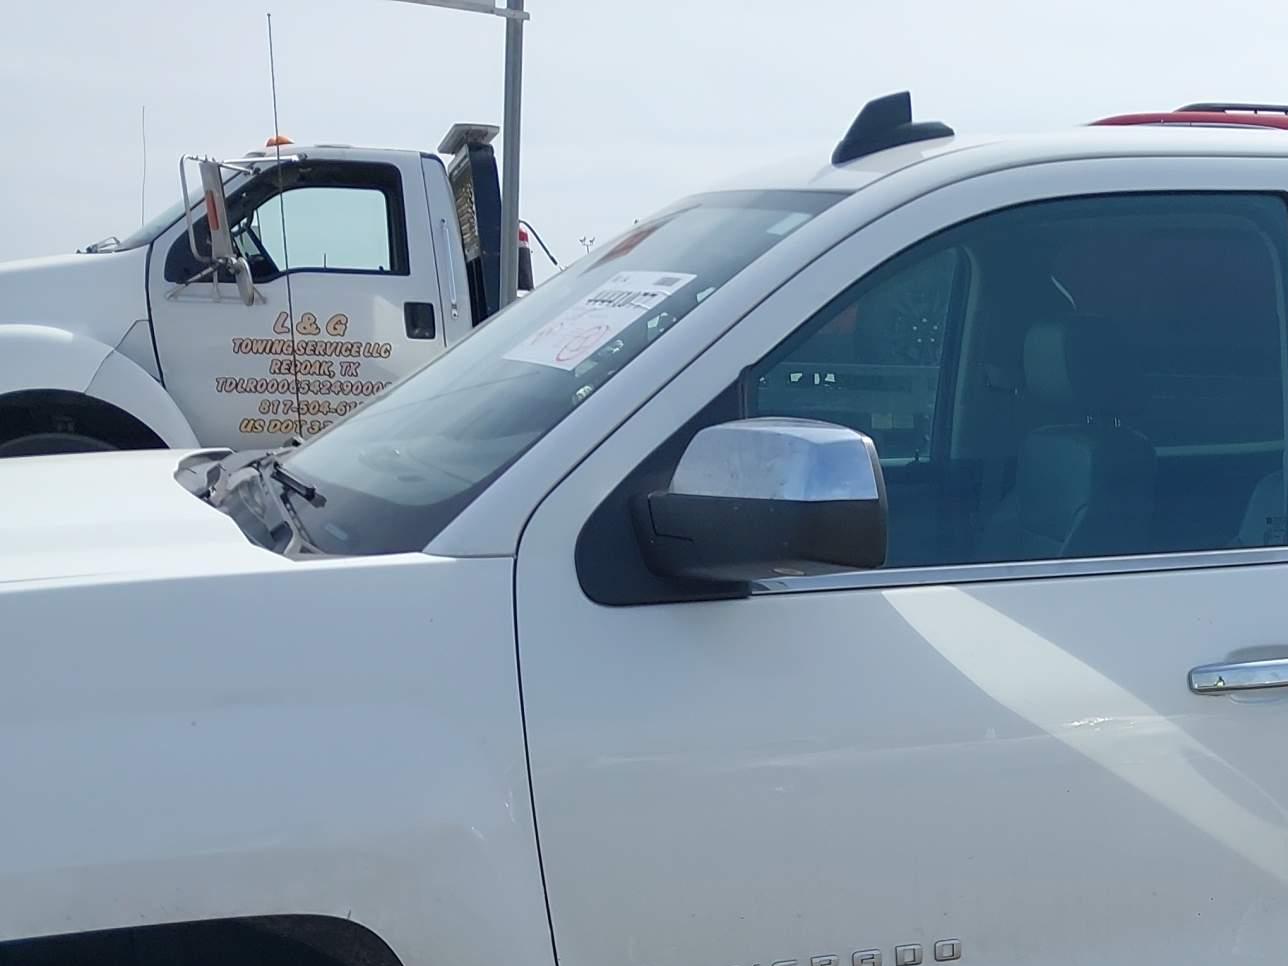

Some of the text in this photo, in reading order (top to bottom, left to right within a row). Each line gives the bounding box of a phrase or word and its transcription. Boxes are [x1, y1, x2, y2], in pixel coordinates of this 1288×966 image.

[273, 311, 349, 337] L & G
[232, 338, 393, 359] TOWING SERVICE LLC
[339, 361, 361, 377] TX
[239, 418, 264, 433] US
[267, 419, 307, 434] DOT
